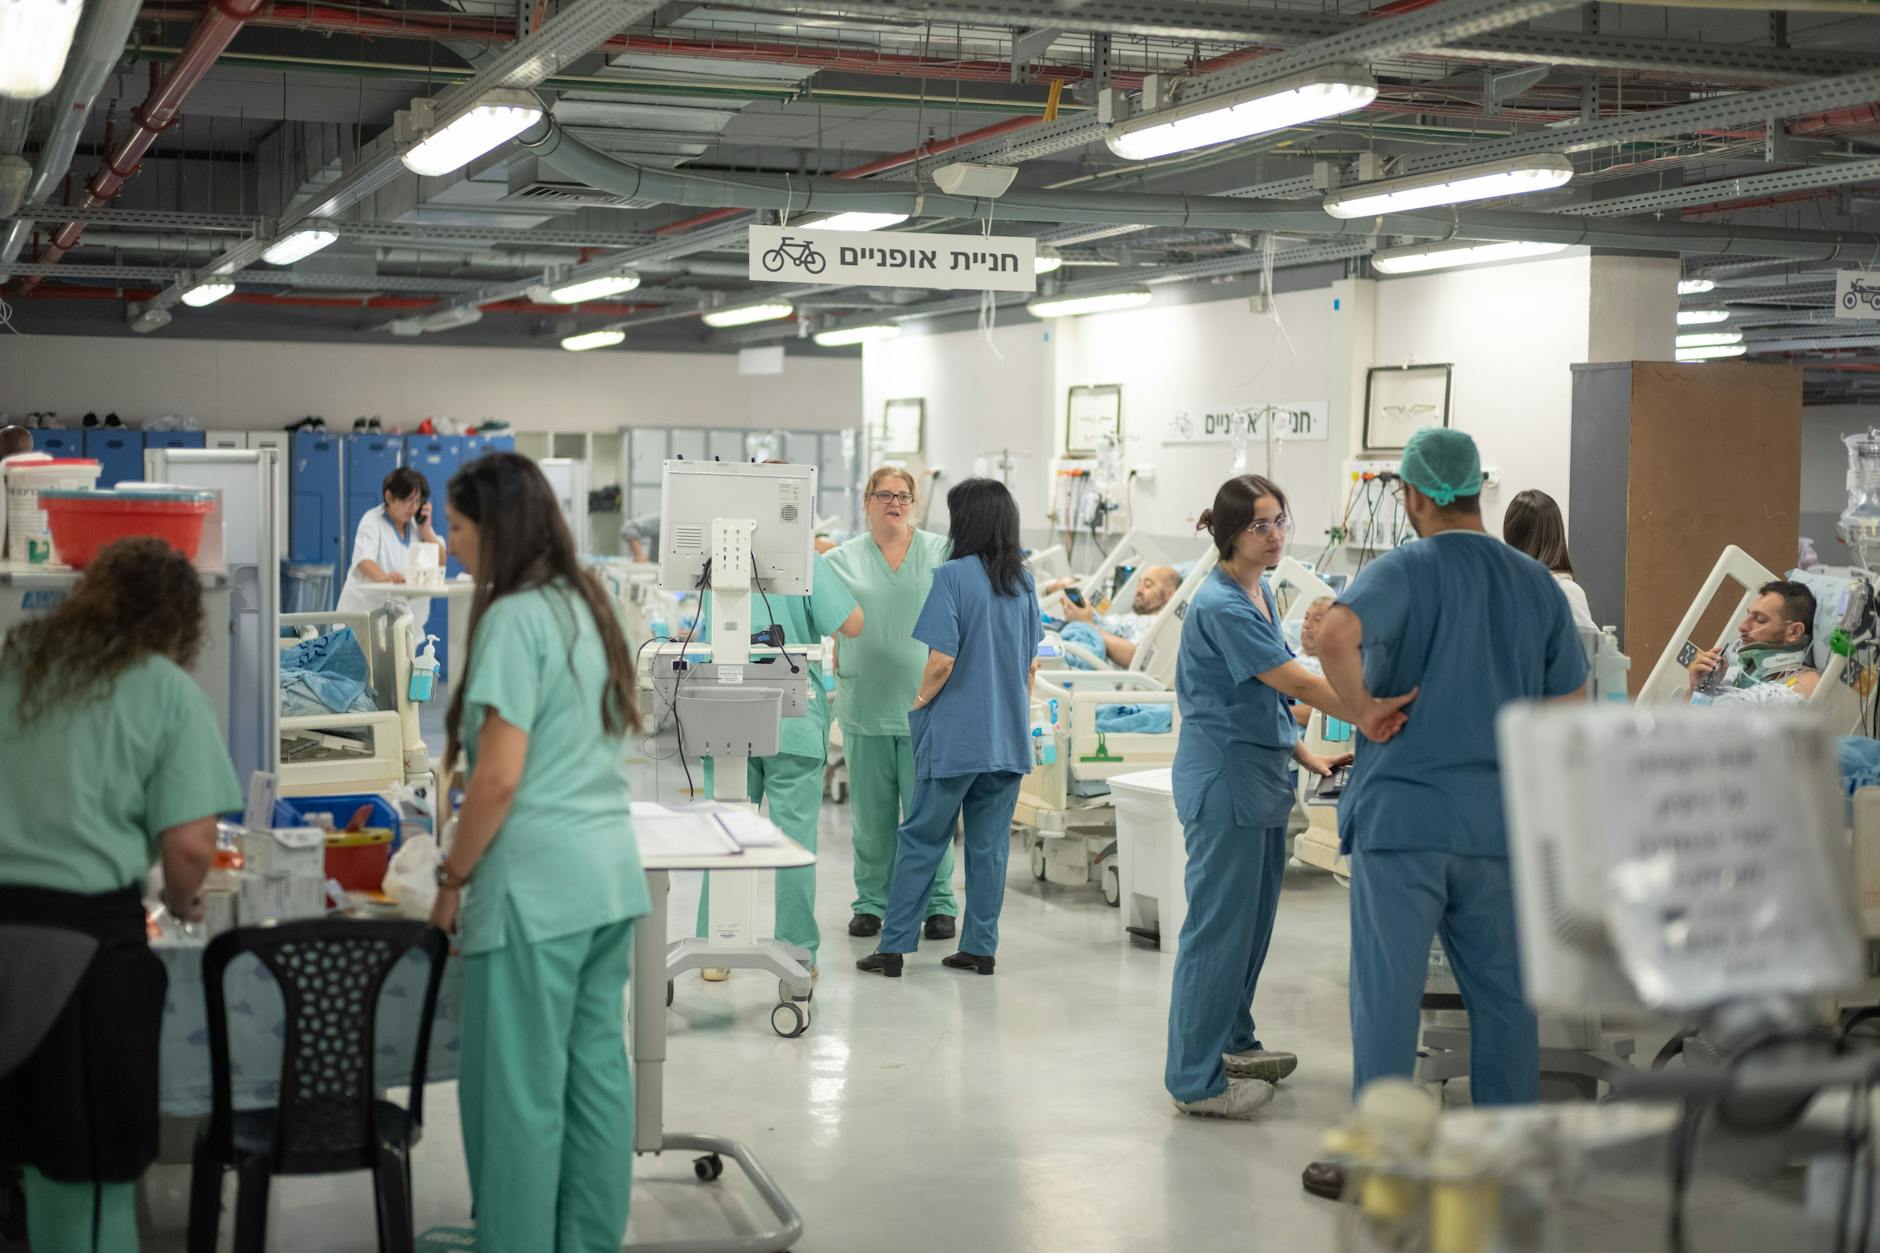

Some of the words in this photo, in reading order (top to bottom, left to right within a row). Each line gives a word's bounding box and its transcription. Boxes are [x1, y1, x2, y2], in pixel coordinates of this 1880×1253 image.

[839, 246, 937, 270] אופניים
[949, 250, 1019, 273] חניית
[1205, 412, 1258, 434] אניים
[1271, 411, 1311, 433] חני
